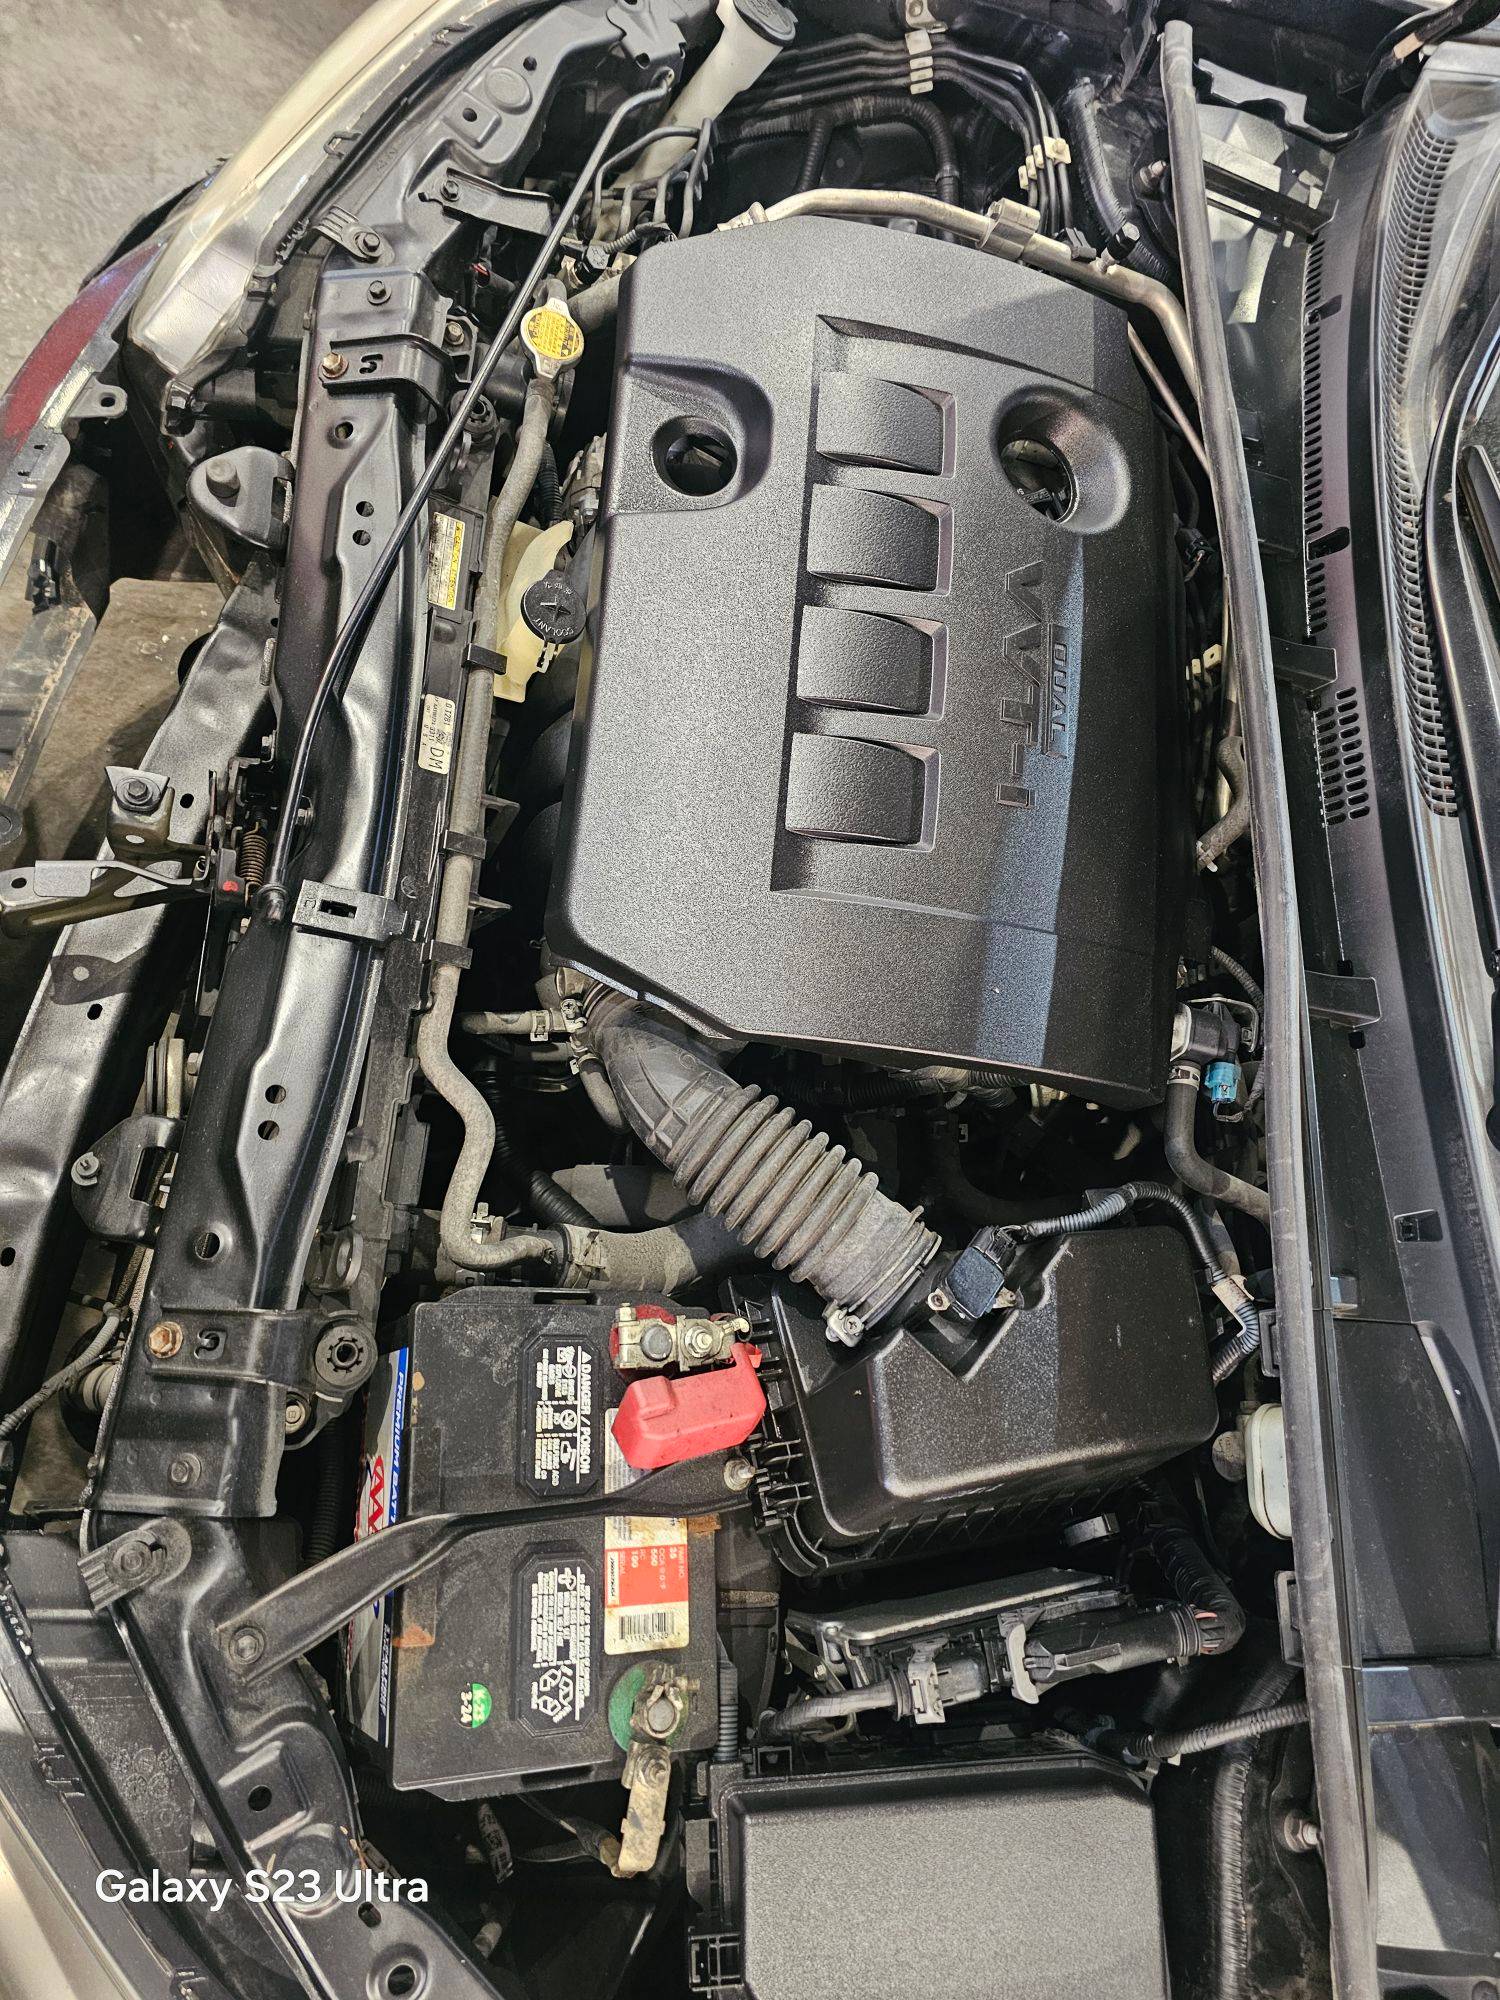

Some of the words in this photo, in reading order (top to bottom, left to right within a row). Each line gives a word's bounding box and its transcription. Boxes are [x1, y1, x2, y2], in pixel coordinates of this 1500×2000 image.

[1050, 643, 1068, 742] DUAL
[429, 747, 444, 769] DM
[581, 1364, 591, 1415] DANGER
[392, 1371, 404, 1467] PREMIUM
[580, 1427, 590, 1474] POISON
